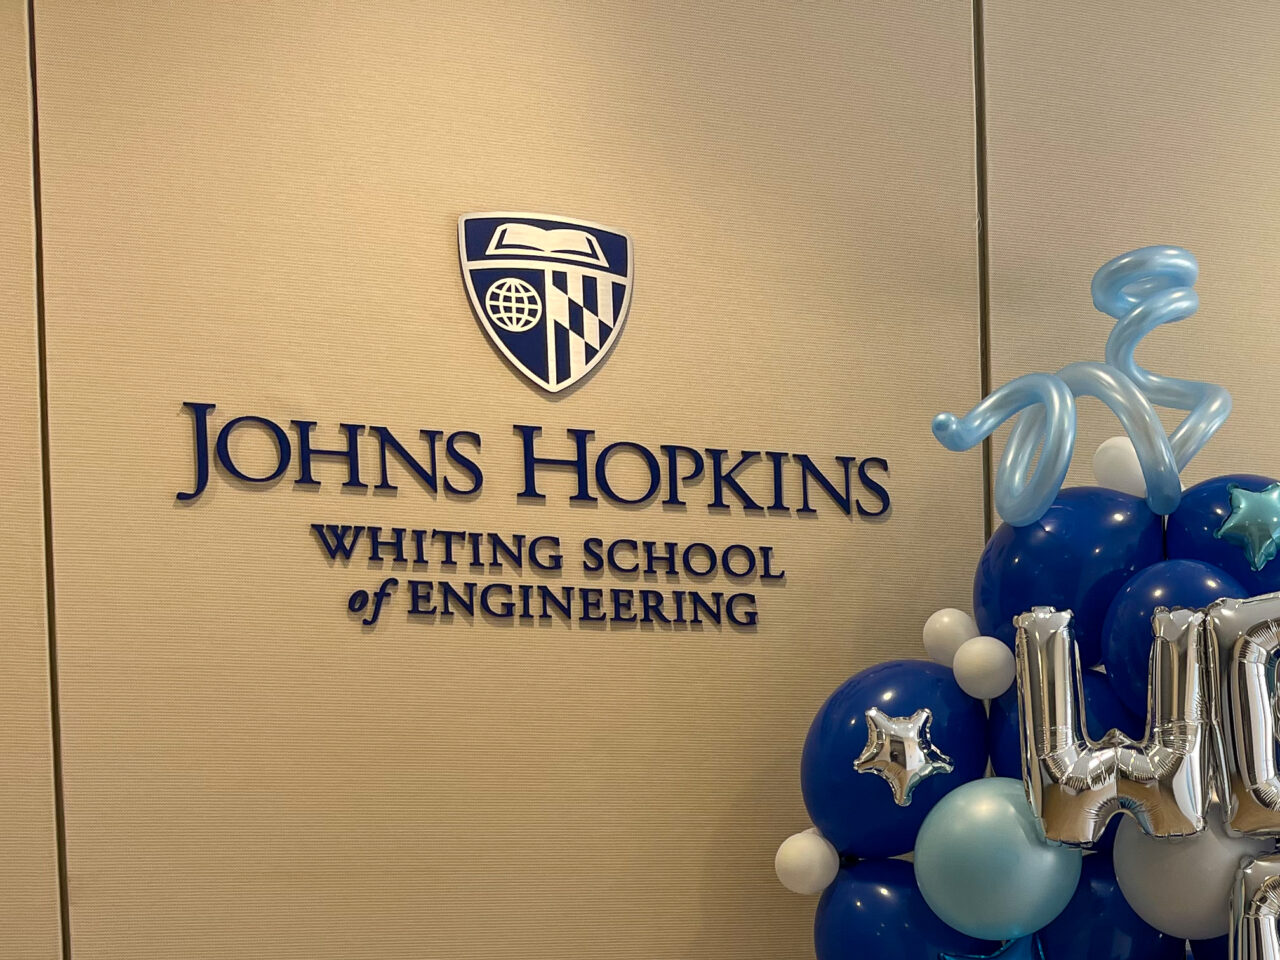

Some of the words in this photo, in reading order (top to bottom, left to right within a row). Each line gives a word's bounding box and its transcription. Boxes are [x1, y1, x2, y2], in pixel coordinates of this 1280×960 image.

[176, 402, 483, 502] JOHNS
[512, 425, 891, 518] HOPKINS
[311, 522, 563, 571] WHITING
[582, 537, 785, 580] SCHOOL
[347, 578, 399, 626] of
[407, 581, 758, 627] ENGINEERING
